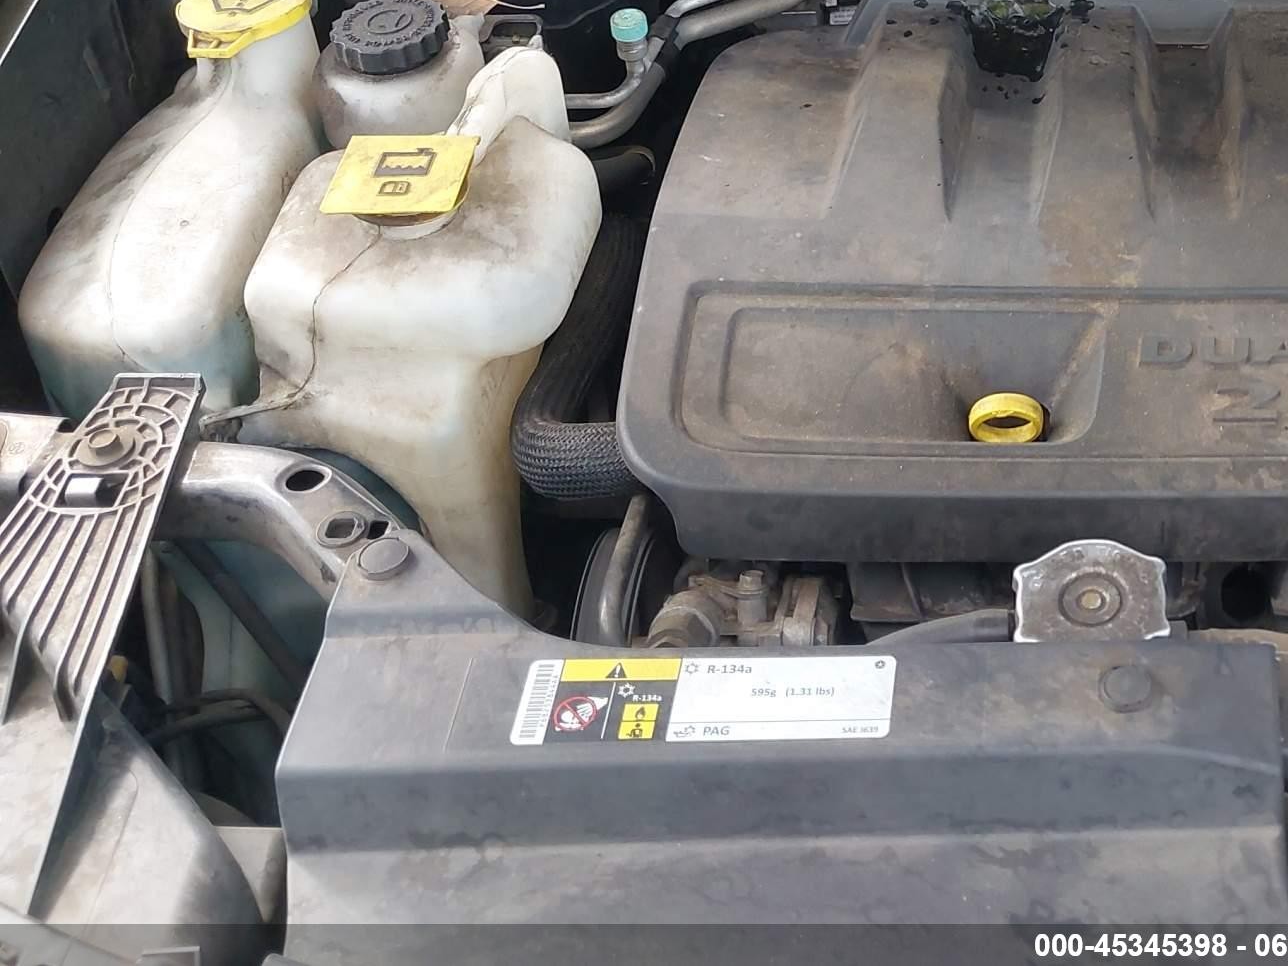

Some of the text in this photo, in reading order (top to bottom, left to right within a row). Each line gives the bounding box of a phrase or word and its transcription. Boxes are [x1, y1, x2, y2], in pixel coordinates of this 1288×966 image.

[706, 664, 752, 674] R-134a
[751, 686, 835, 698] 595g (1.31 lbs)
[632, 694, 663, 702] R-134a
[702, 725, 731, 736] PAG
